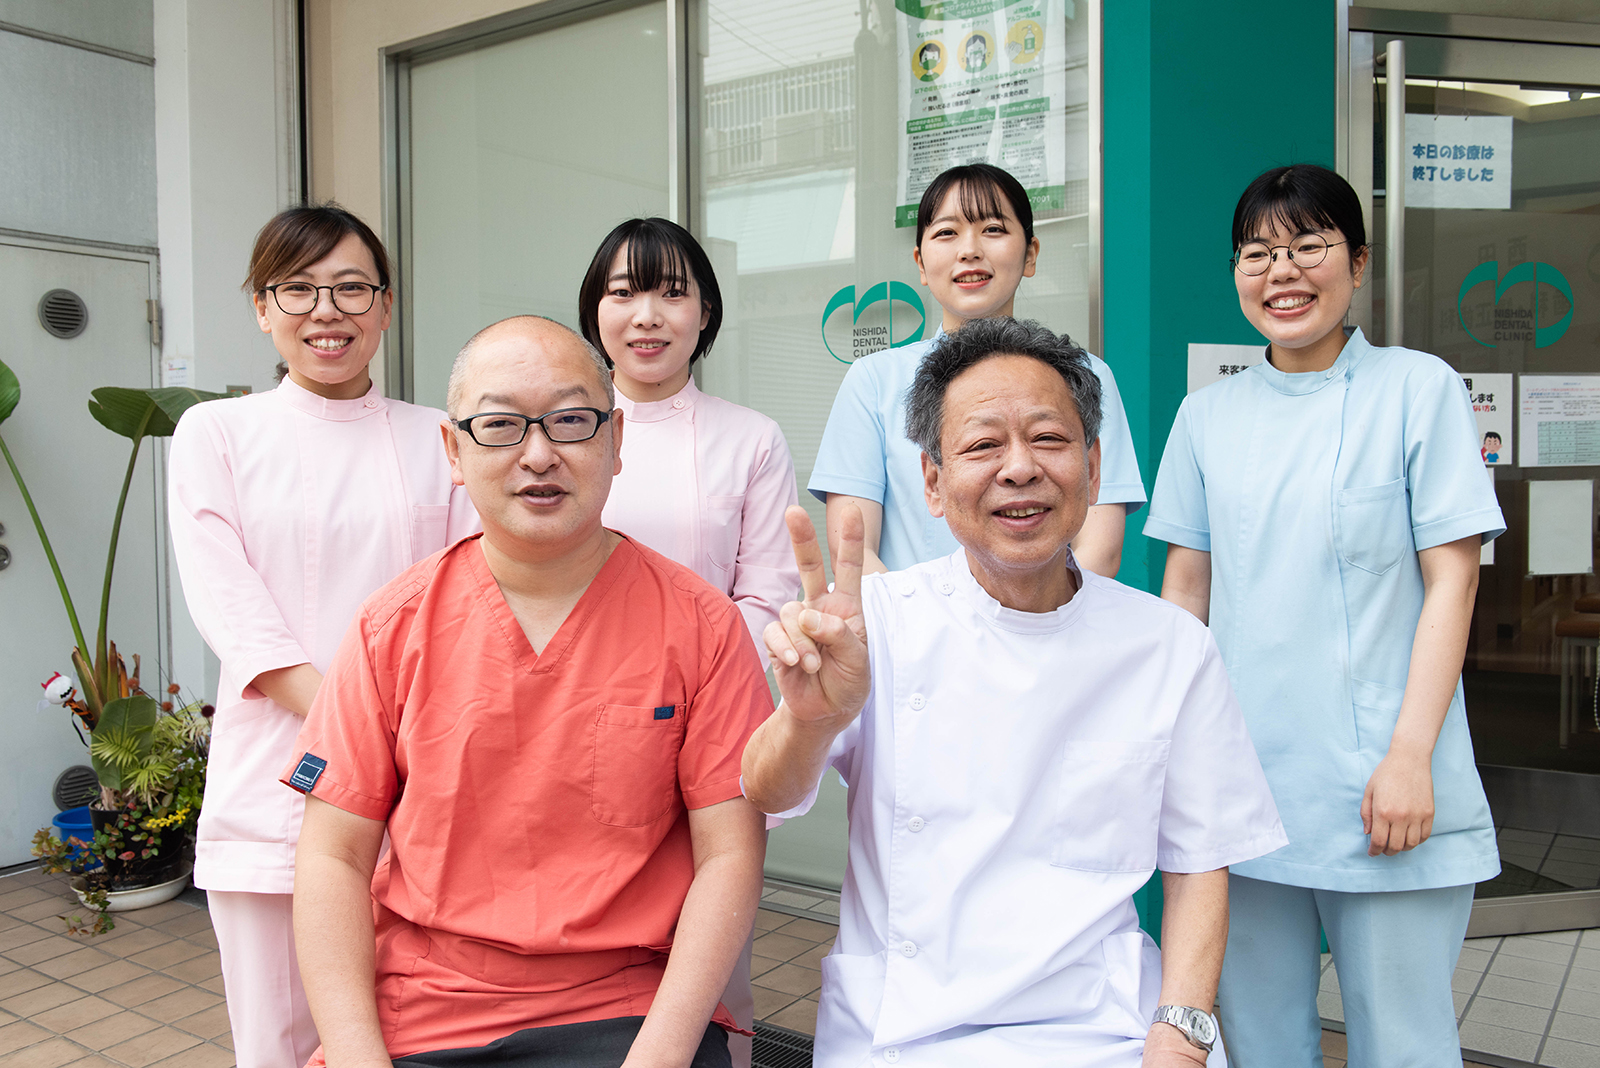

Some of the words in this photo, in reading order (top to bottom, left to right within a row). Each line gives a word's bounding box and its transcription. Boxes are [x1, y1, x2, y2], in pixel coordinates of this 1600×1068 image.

[1412, 143, 1494, 160] 本日の診療は
[1412, 165, 1494, 182] 終了しました
[1494, 309, 1533, 318] NISHIDA
[1494, 320, 1533, 330] DENTAL
[853, 326, 887, 336] NISHIDA
[1494, 331, 1533, 341] CLINIC
[853, 337, 887, 347] DENTAL
[853, 347, 887, 357] CLIN
